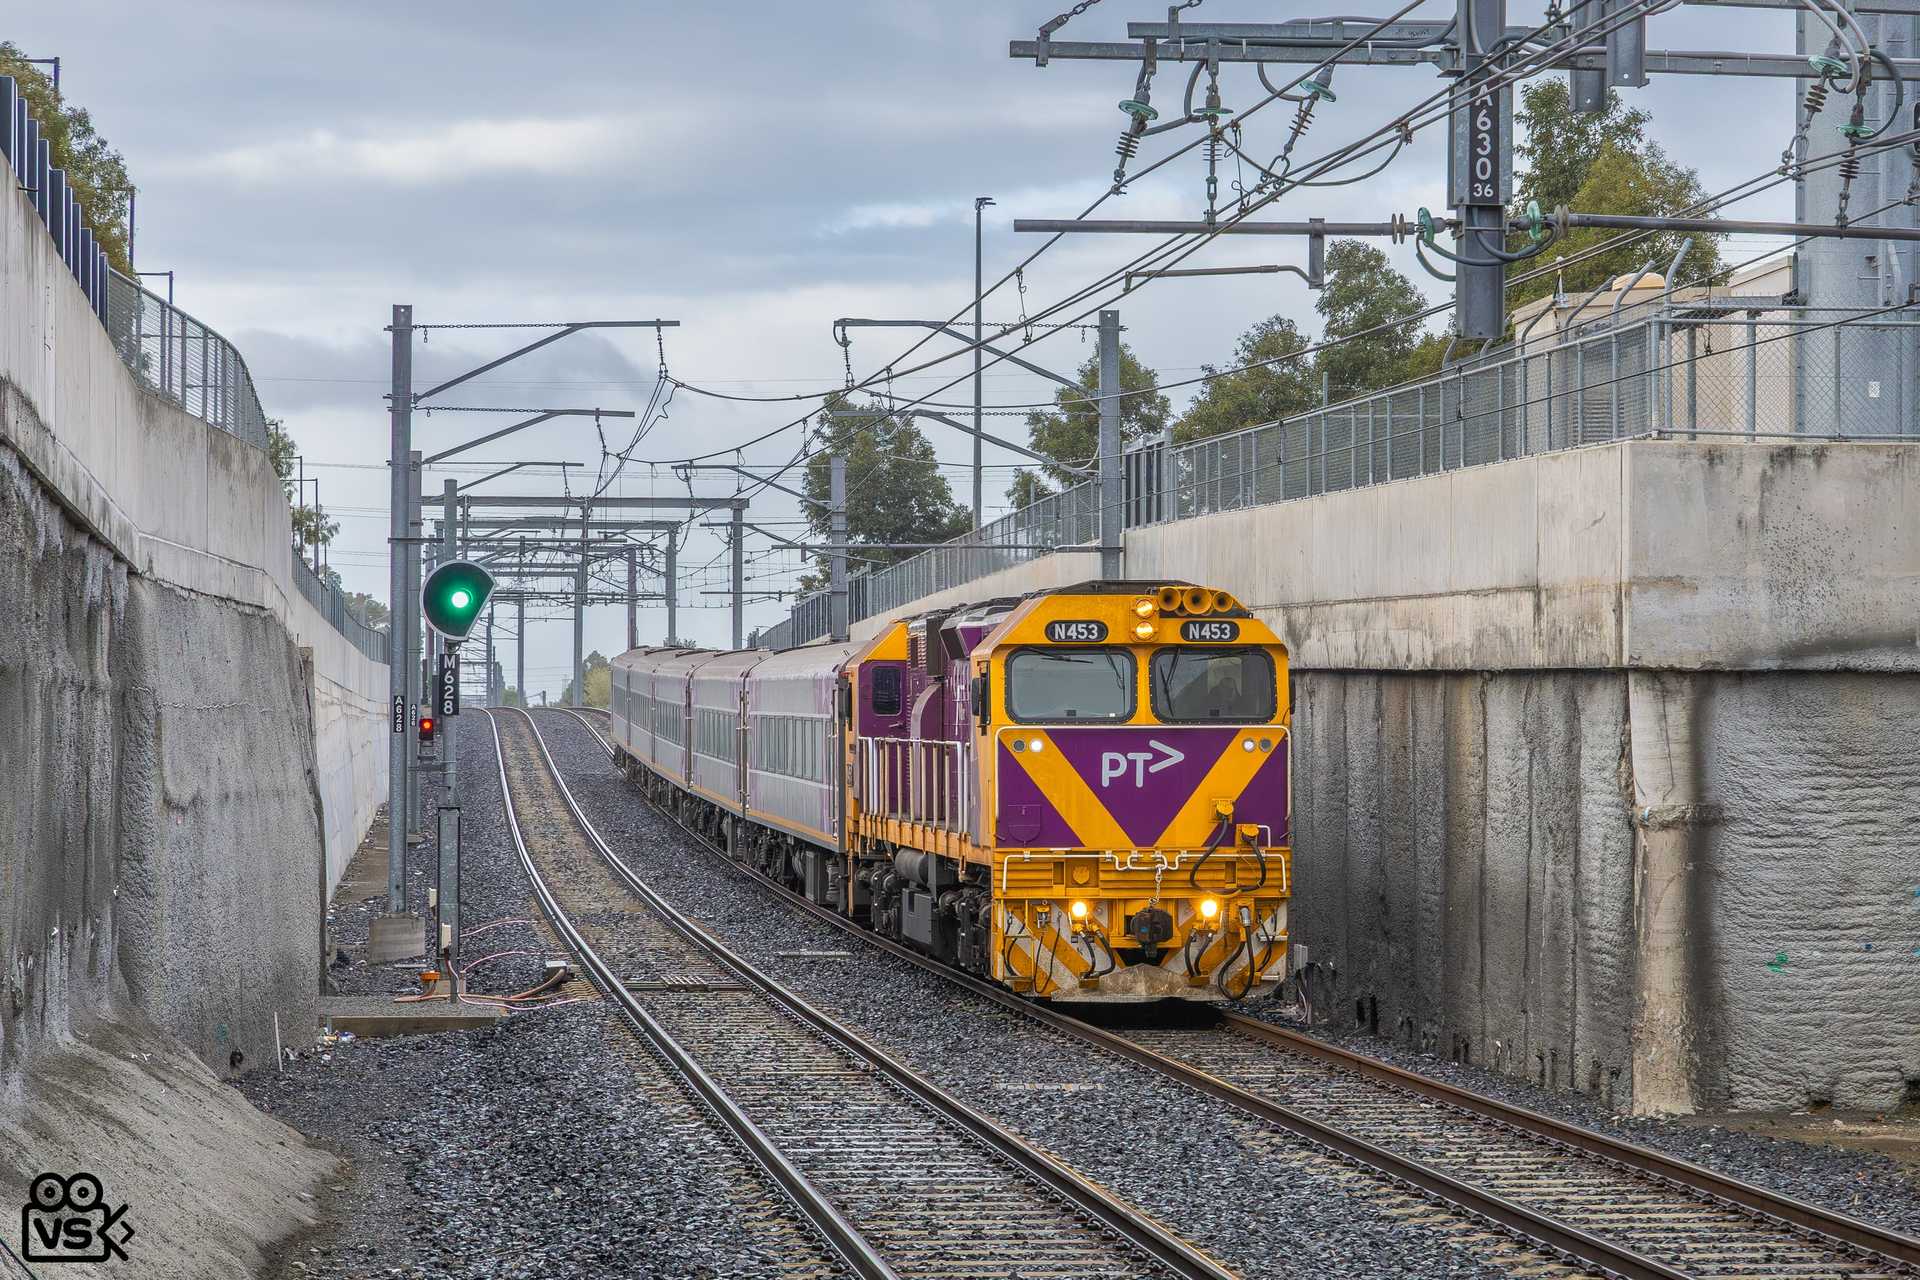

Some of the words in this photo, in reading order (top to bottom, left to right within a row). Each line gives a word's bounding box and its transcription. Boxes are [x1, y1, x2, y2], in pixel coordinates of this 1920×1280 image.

[1474, 84, 1494, 181] A630
[1472, 183, 1494, 197] 36
[1053, 623, 1099, 641] N453
[1188, 623, 1232, 641] N453
[444, 655, 456, 714] M628
[395, 696, 403, 732] A628
